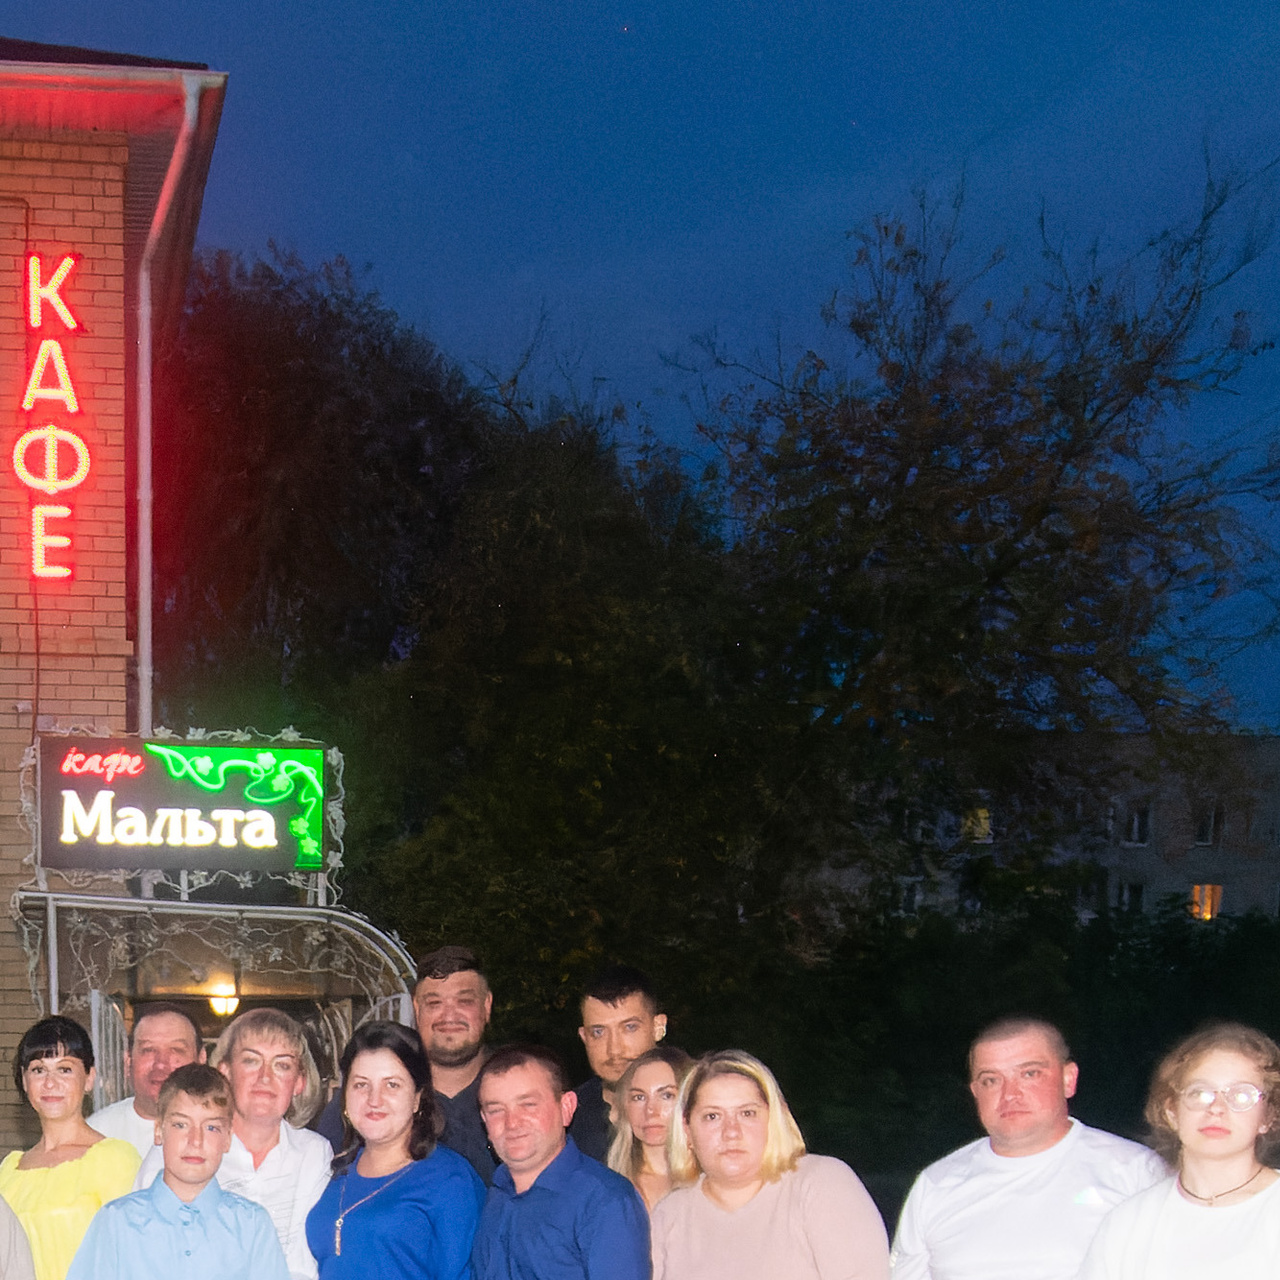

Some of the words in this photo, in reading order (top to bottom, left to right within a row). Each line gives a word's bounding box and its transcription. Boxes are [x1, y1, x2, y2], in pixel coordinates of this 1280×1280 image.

[13, 256, 90, 577] КАФЕ
[60, 746, 145, 783] кафе
[60, 789, 278, 848] Мальта
